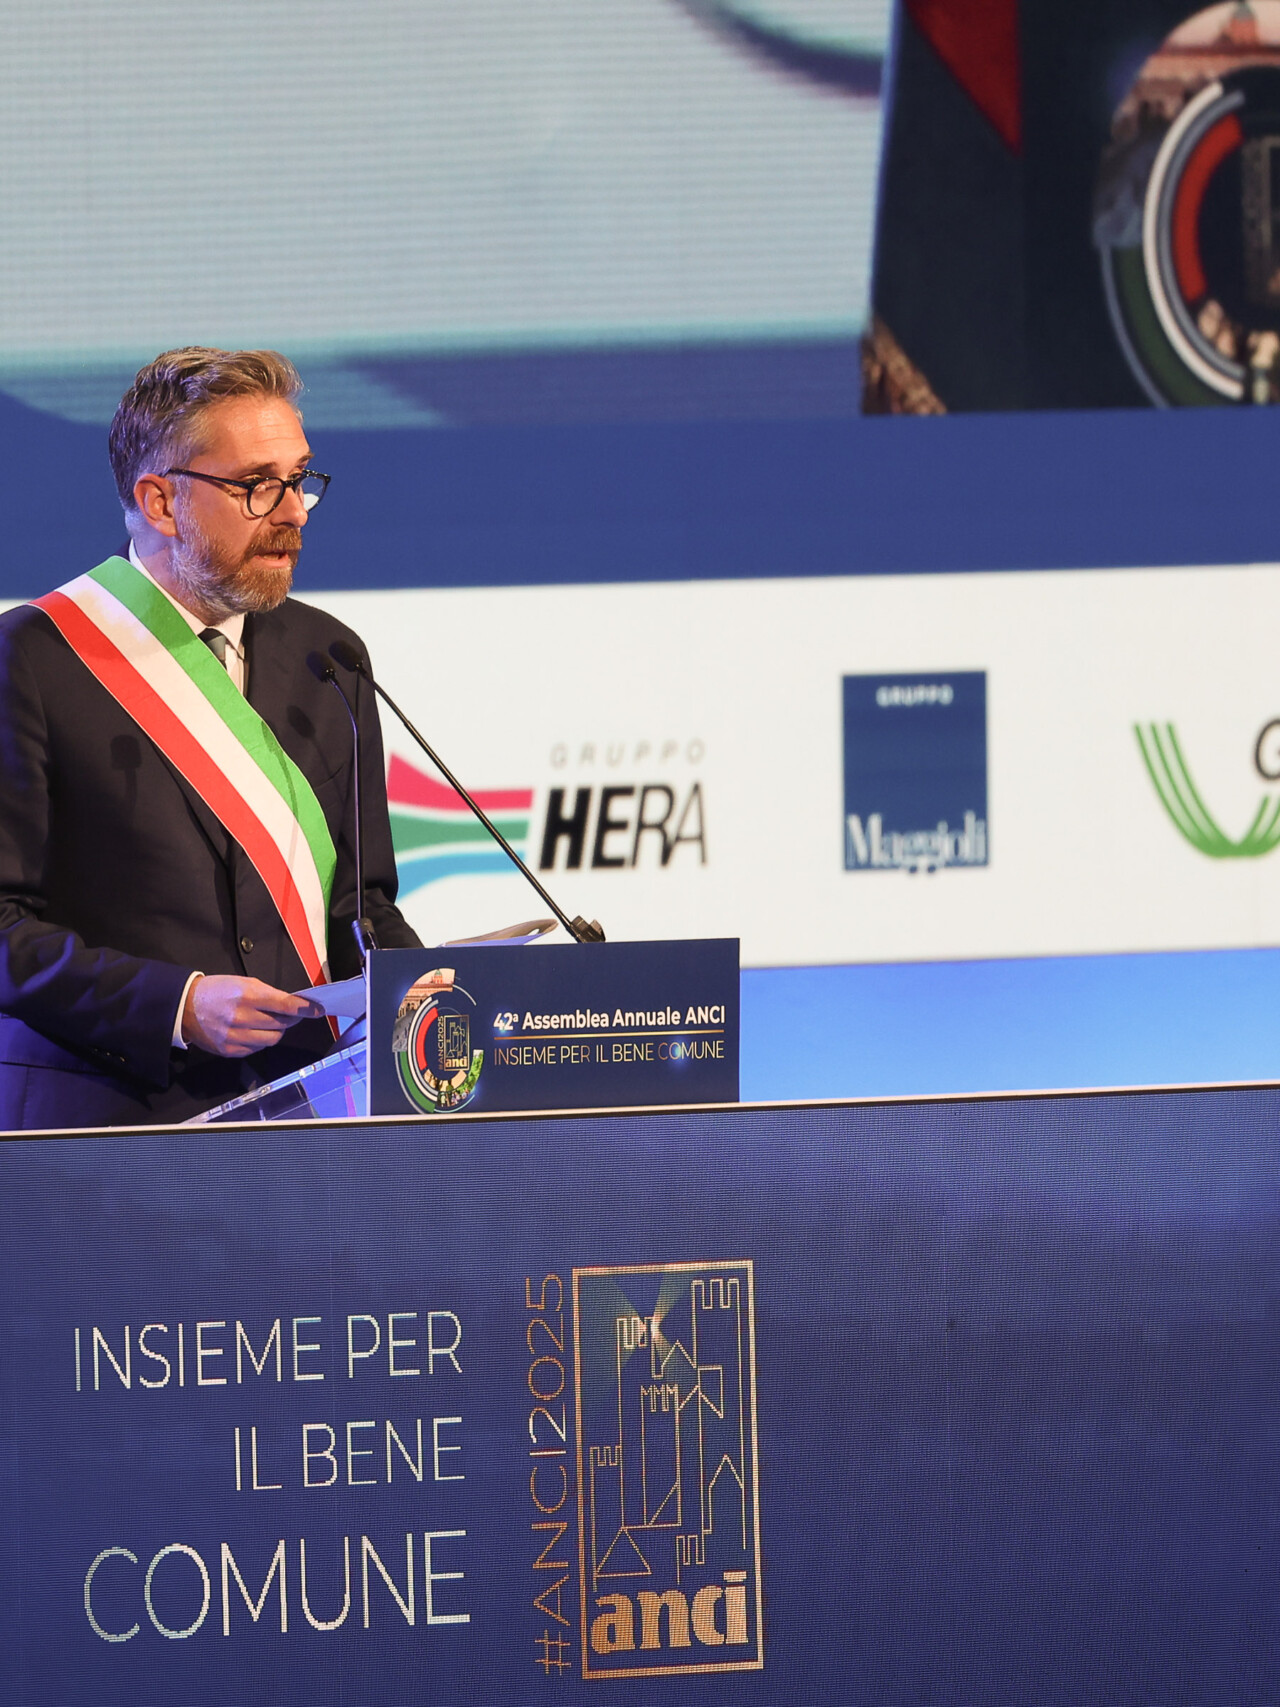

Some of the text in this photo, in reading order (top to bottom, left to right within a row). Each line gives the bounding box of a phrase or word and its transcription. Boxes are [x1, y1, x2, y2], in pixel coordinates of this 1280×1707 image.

[549, 738, 706, 770] GRUPPO
[538, 780, 707, 871] HERA
[846, 809, 987, 875] Maggioli
[494, 1040, 725, 1066] INSIEME PER IL BENE COMUNE
[522, 1008, 610, 1030] Assemblea
[612, 1006, 681, 1027] Annuale
[685, 1005, 725, 1025] ANCI
[445, 1056, 468, 1068] anci
[74, 1310, 463, 1392] INSIEME PER
[234, 1416, 466, 1491] IL BENE
[526, 1274, 572, 1676] #ANCI2025
[83, 1529, 471, 1642] COMUNE
[590, 1570, 749, 1655] anci
